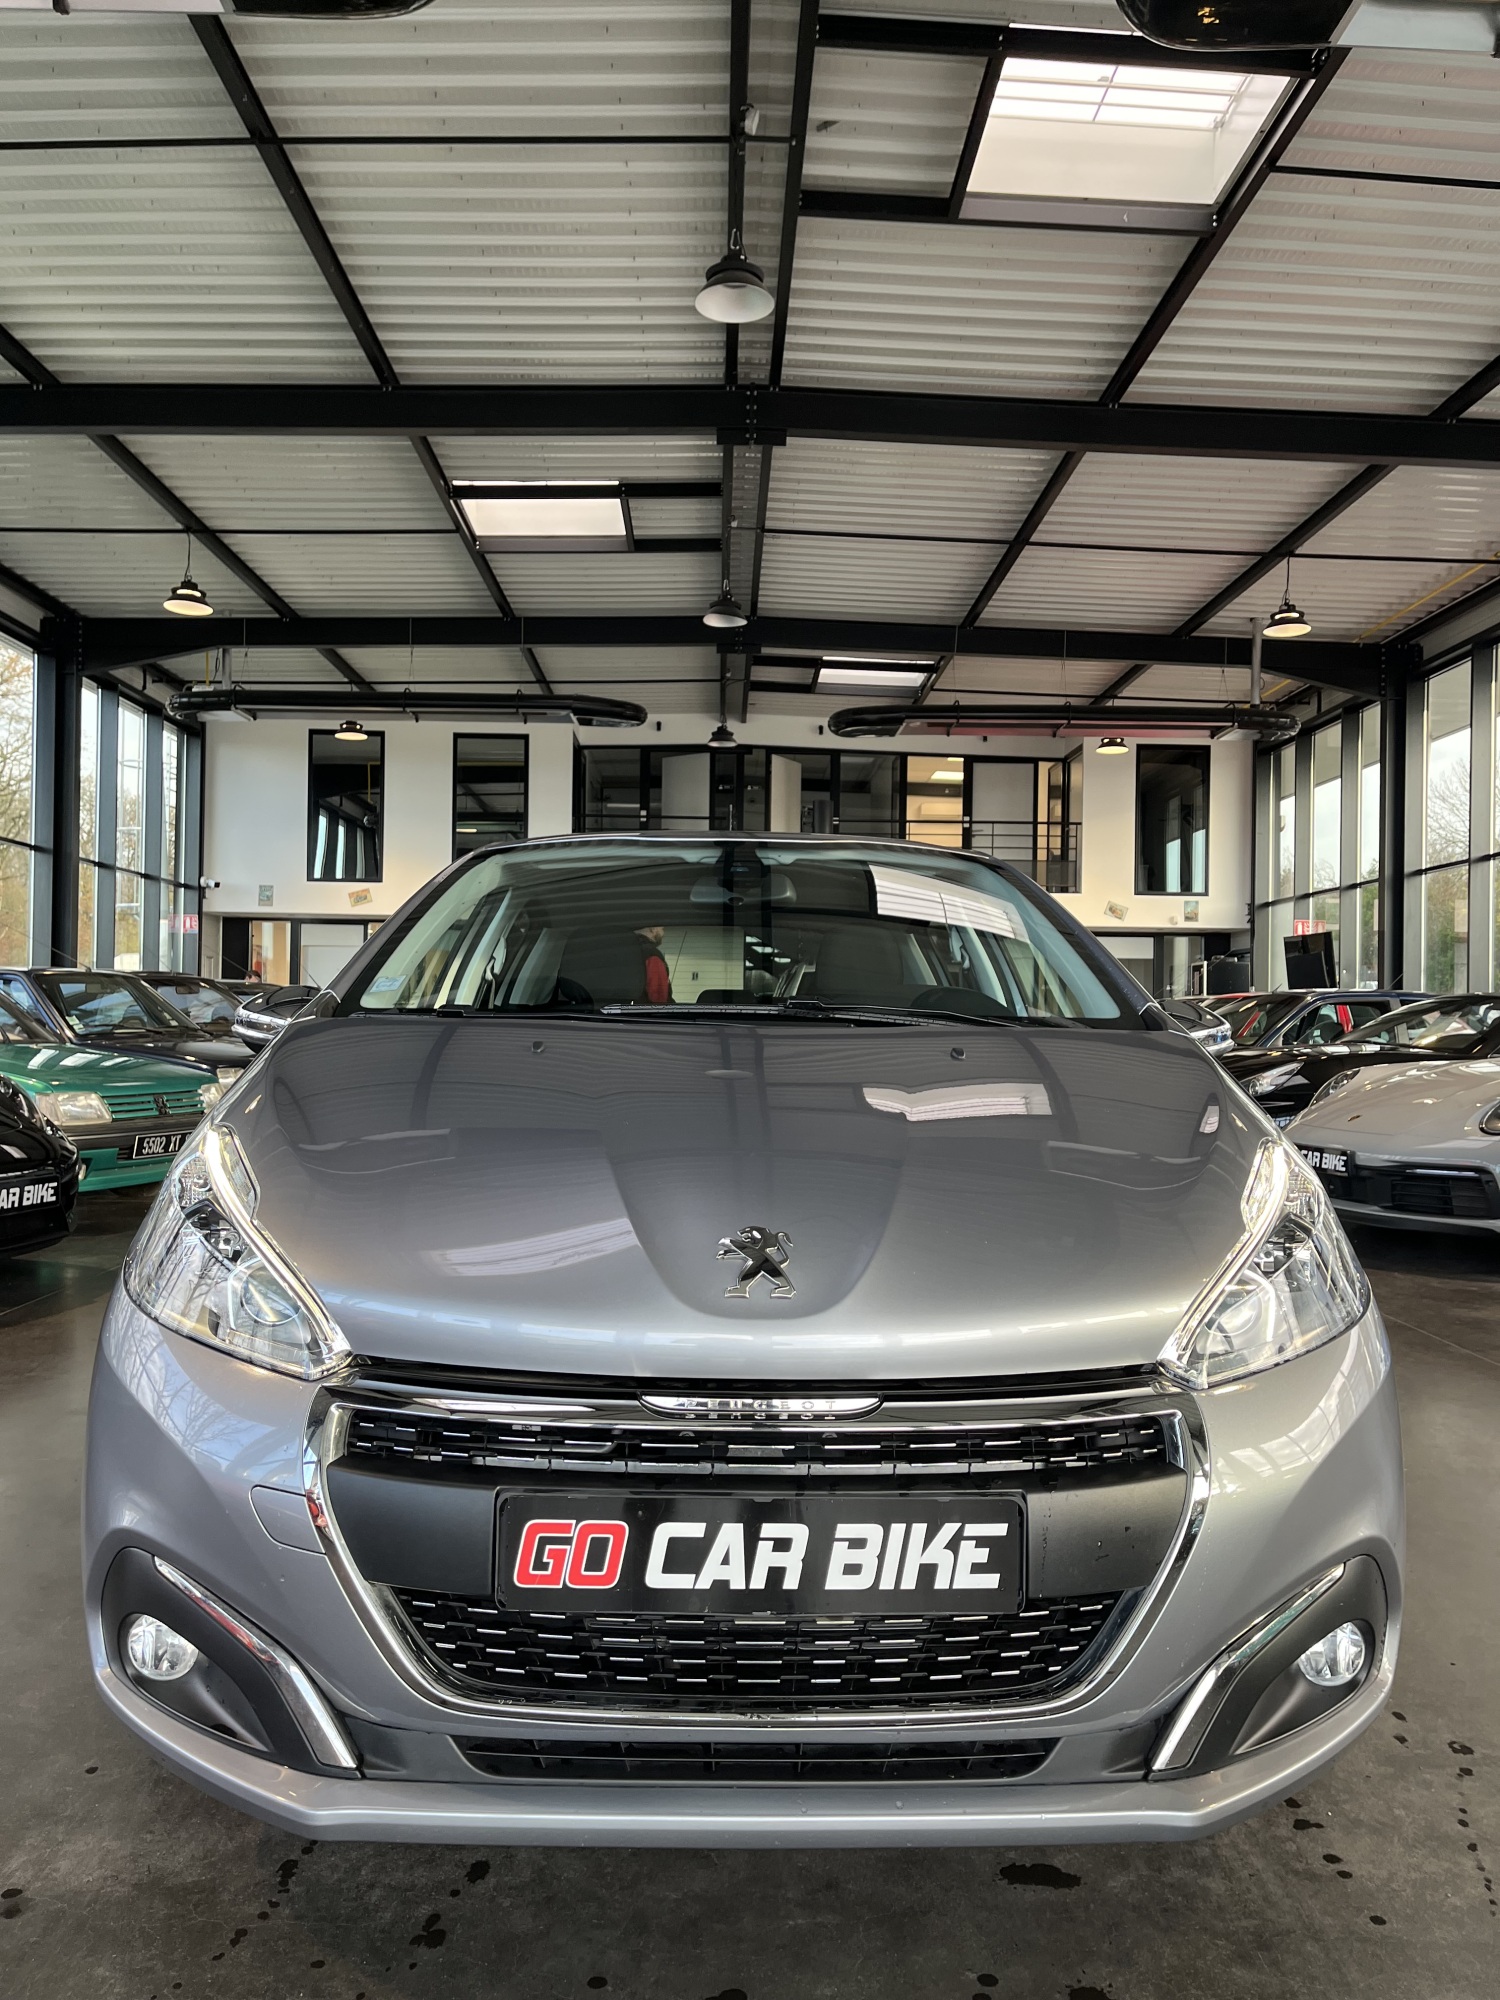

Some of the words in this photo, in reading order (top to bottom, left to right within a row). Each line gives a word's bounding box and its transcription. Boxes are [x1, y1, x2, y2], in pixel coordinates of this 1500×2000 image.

[142, 1136, 166, 1155] 5502
[1321, 1152, 1347, 1171] BIKE
[0, 1187, 20, 1209] AR
[22, 1182, 58, 1206] BIKE
[684, 1398, 836, 1410] PEUGEOT
[513, 1519, 629, 1589] GO
[644, 1521, 810, 1590] CAR
[824, 1521, 1009, 1591] BIKE
